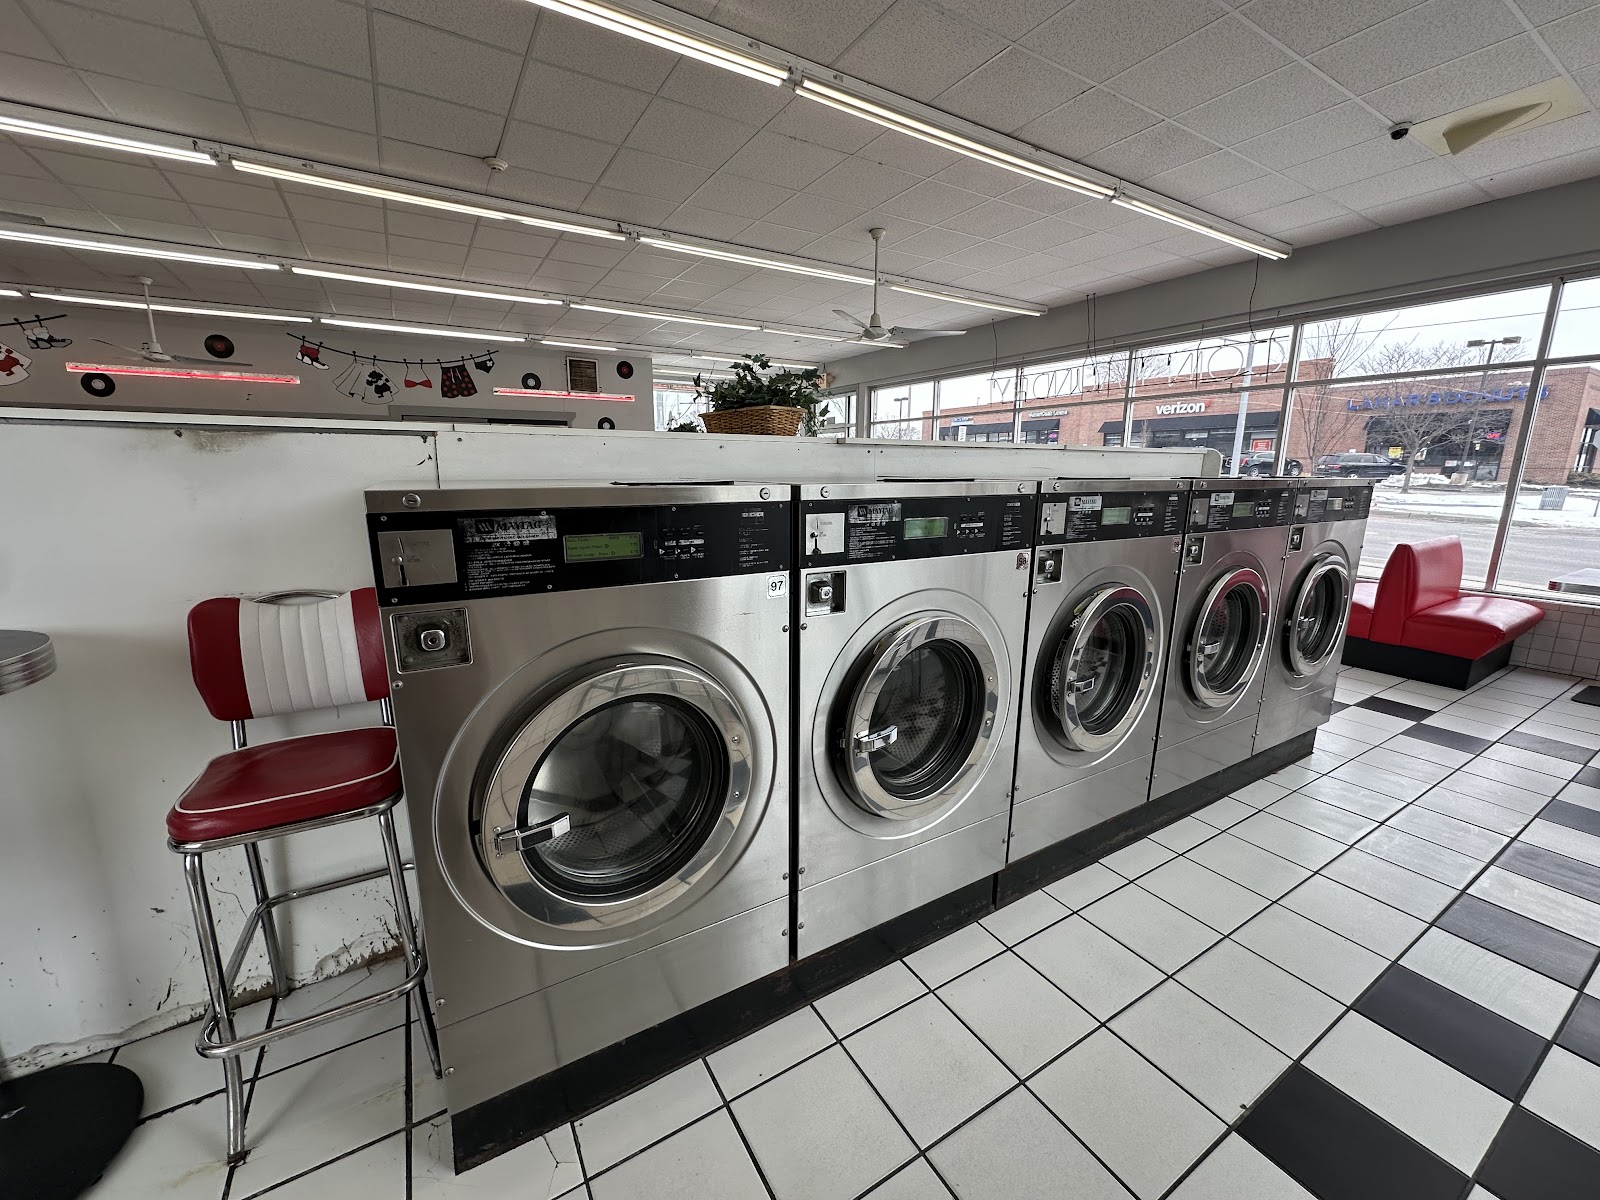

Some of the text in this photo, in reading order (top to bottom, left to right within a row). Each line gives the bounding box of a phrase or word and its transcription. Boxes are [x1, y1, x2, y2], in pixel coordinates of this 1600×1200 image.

[1156, 401, 1206, 415] verizon
[496, 520, 541, 531] MAYTAG
[770, 580, 784, 592] 97
